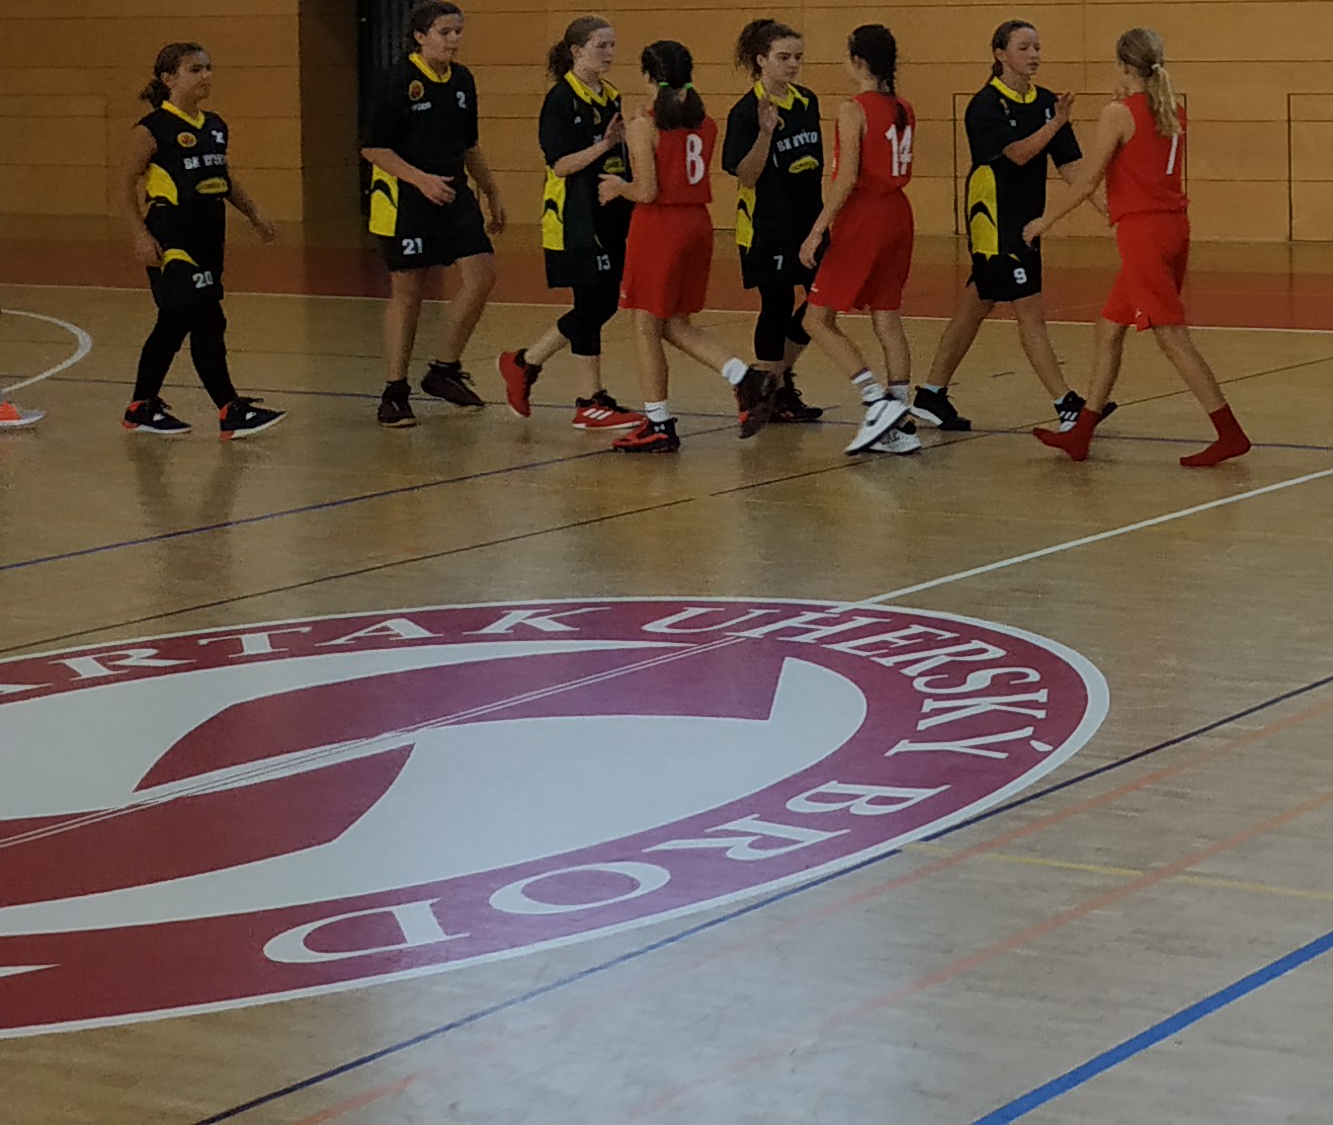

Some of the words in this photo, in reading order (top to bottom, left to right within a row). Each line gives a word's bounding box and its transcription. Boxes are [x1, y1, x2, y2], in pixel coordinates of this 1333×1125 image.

[685, 133, 705, 185] 8
[884, 123, 912, 176] 14
[402, 237, 424, 256] 21
[596, 253, 611, 272] 13
[773, 255, 784, 271] 7
[193, 270, 214, 289] 20
[641, 606, 1053, 759] UHERSKÝ
[263, 779, 951, 965] BROD
